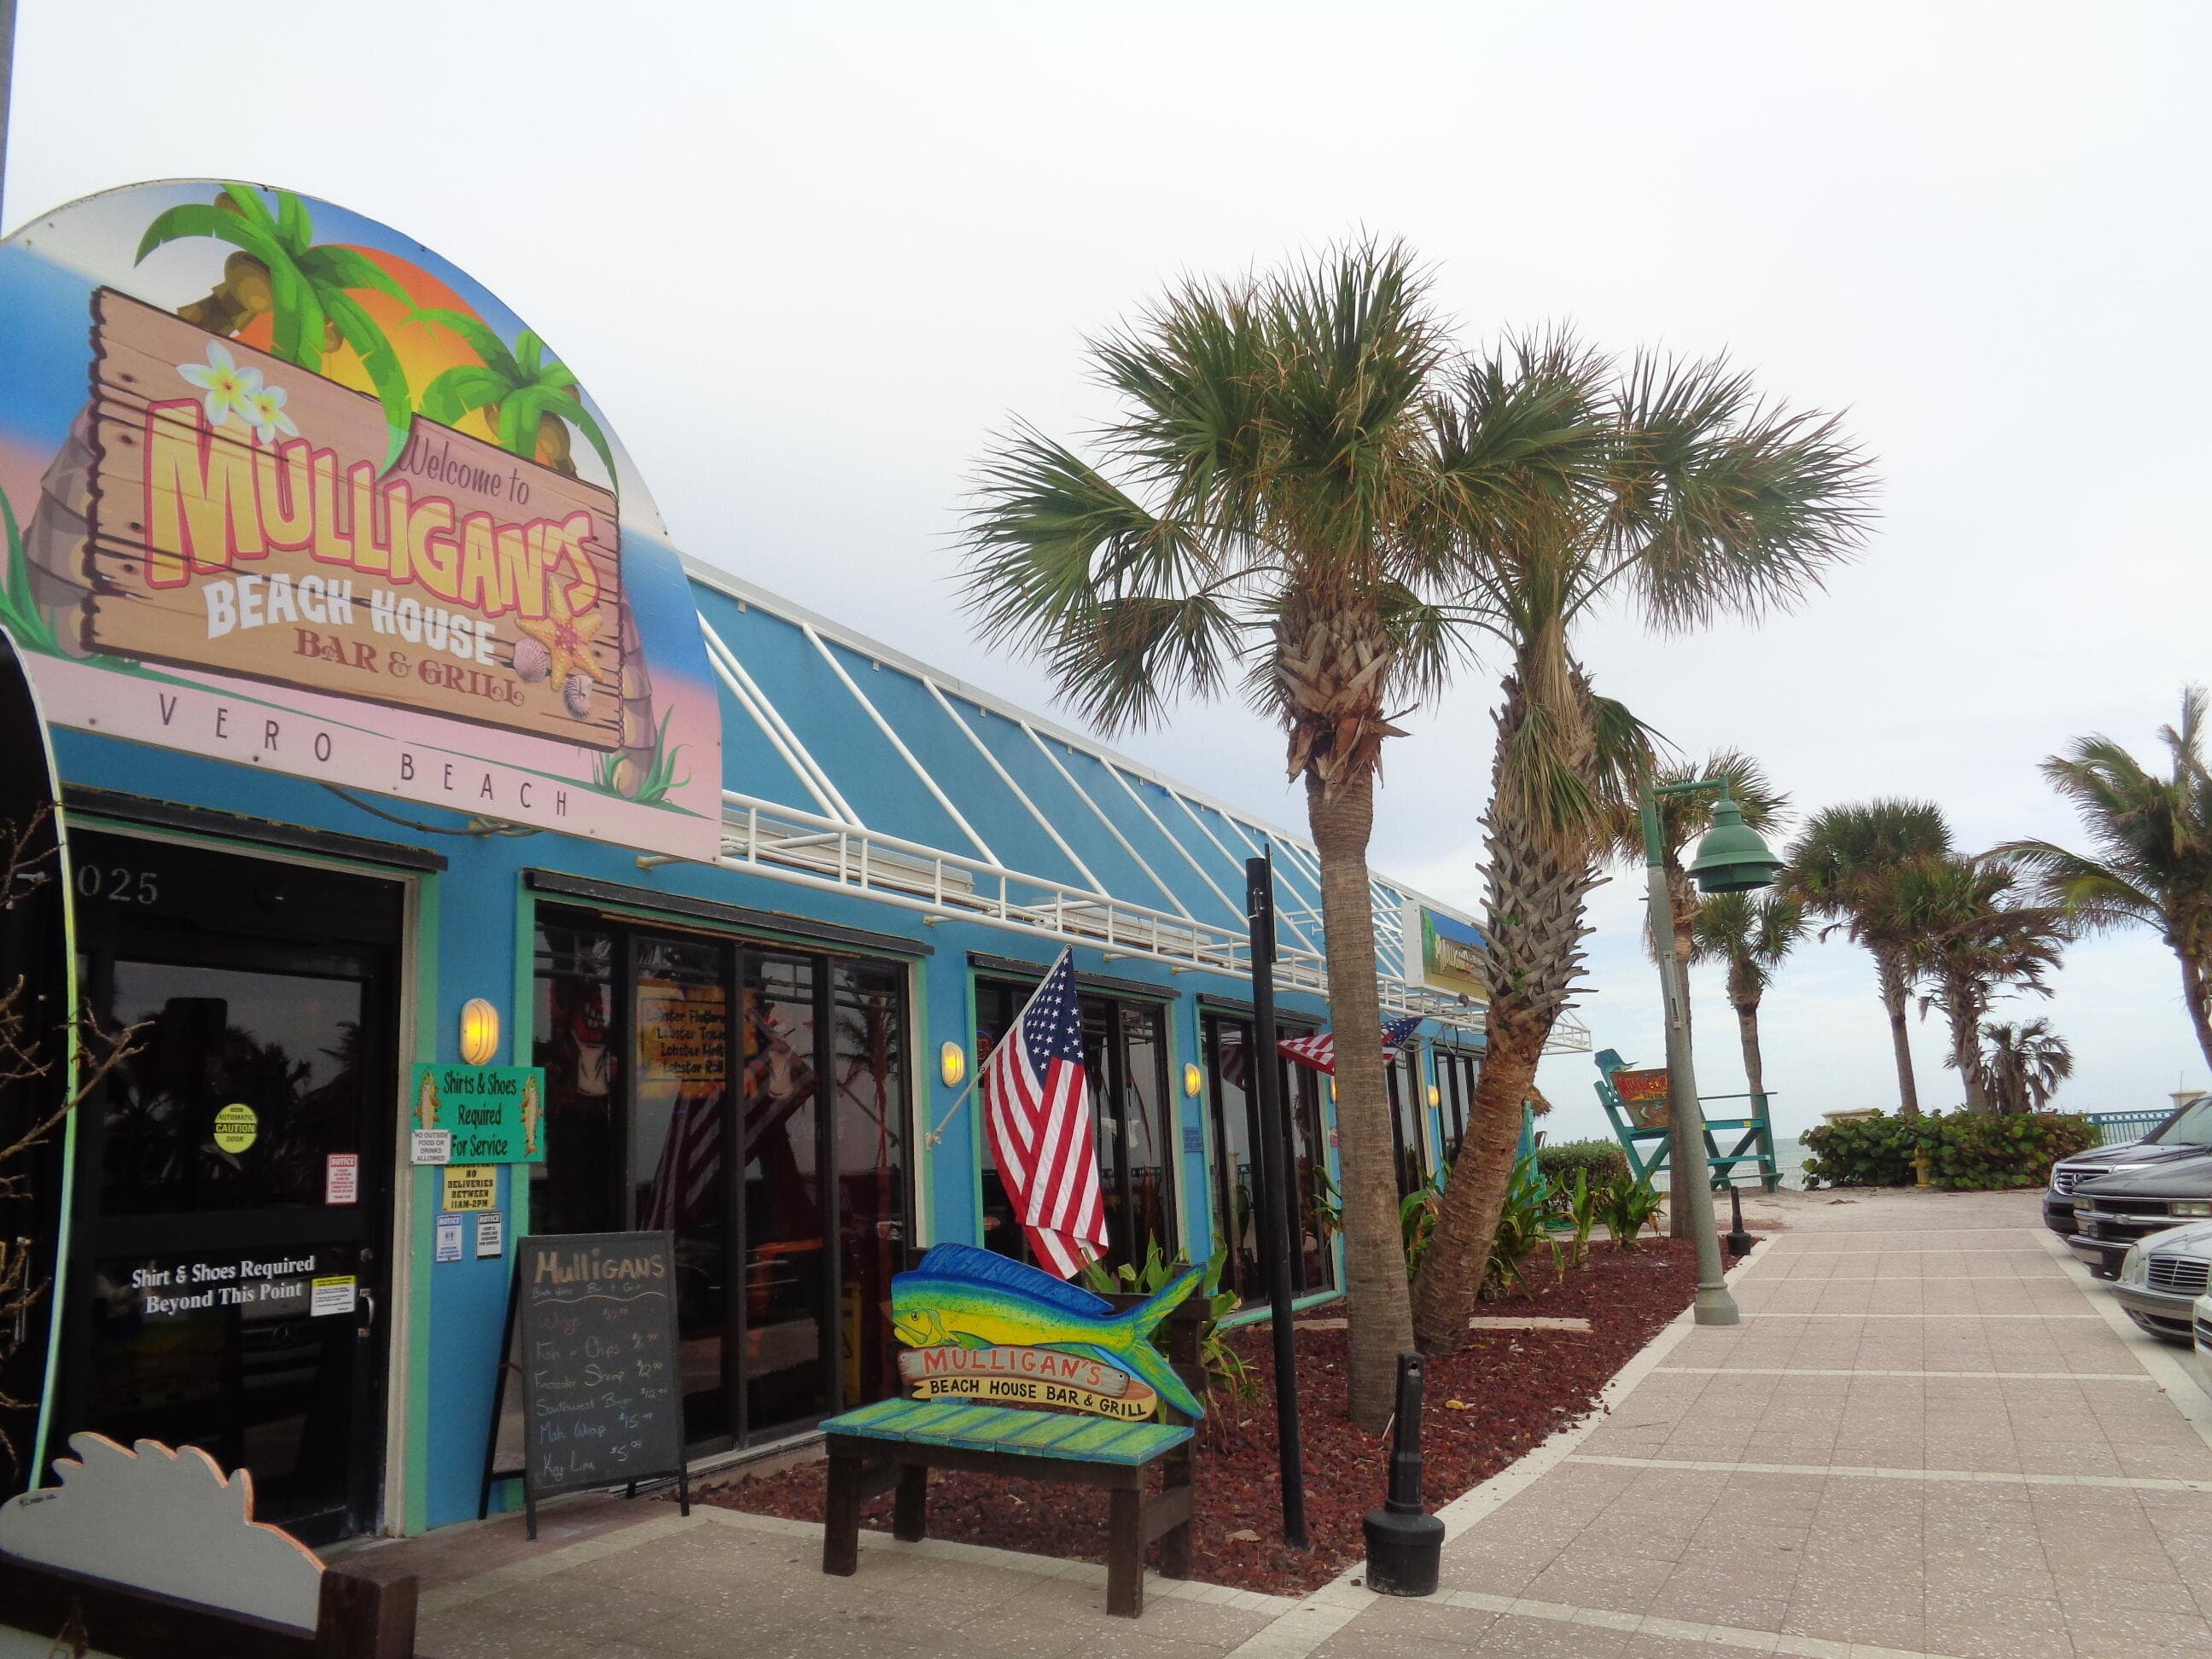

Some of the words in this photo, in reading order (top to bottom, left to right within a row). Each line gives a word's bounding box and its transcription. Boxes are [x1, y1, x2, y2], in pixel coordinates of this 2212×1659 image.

[398, 434, 504, 498] Welcome
[508, 467, 530, 505] to
[144, 399, 601, 620] MULLIGAN'S
[204, 573, 354, 639] BEACH
[370, 587, 498, 667] HOUSE
[294, 627, 382, 676] BAR
[387, 652, 413, 678] &
[417, 657, 526, 707] GRILL
[158, 692, 333, 763] VERO
[400, 753, 568, 818] BEACH
[443, 1070, 474, 1095] Shirts
[476, 1074, 486, 1095] &
[487, 1072, 517, 1096] Shoes
[215, 1123, 255, 1133] CAUTION
[457, 1103, 502, 1130] Required
[451, 1135, 468, 1156] For
[470, 1134, 509, 1157] Service
[330, 1157, 355, 1167] NOTICE
[465, 1169, 477, 1179] NO
[447, 1179, 494, 1189] DELIVERIES
[451, 1190, 489, 1199] BETWEEN
[451, 1199, 488, 1209] 11AM-2PM
[479, 1214, 500, 1224] NOTICE
[131, 1268, 171, 1289] Shirt
[175, 1265, 187, 1284] &
[191, 1263, 236, 1283] Shoes
[239, 1254, 316, 1280] Required
[144, 1289, 213, 1315] Beyond
[218, 1286, 255, 1306] This
[259, 1282, 303, 1301] Point
[922, 1347, 1102, 1388] MULLIGAN'S
[930, 1378, 980, 1394] BEACH
[989, 1381, 1037, 1400] HOUSE
[1046, 1386, 1080, 1406] BAR
[1083, 1394, 1093, 1407] &
[1099, 1398, 1147, 1417] GRILL
